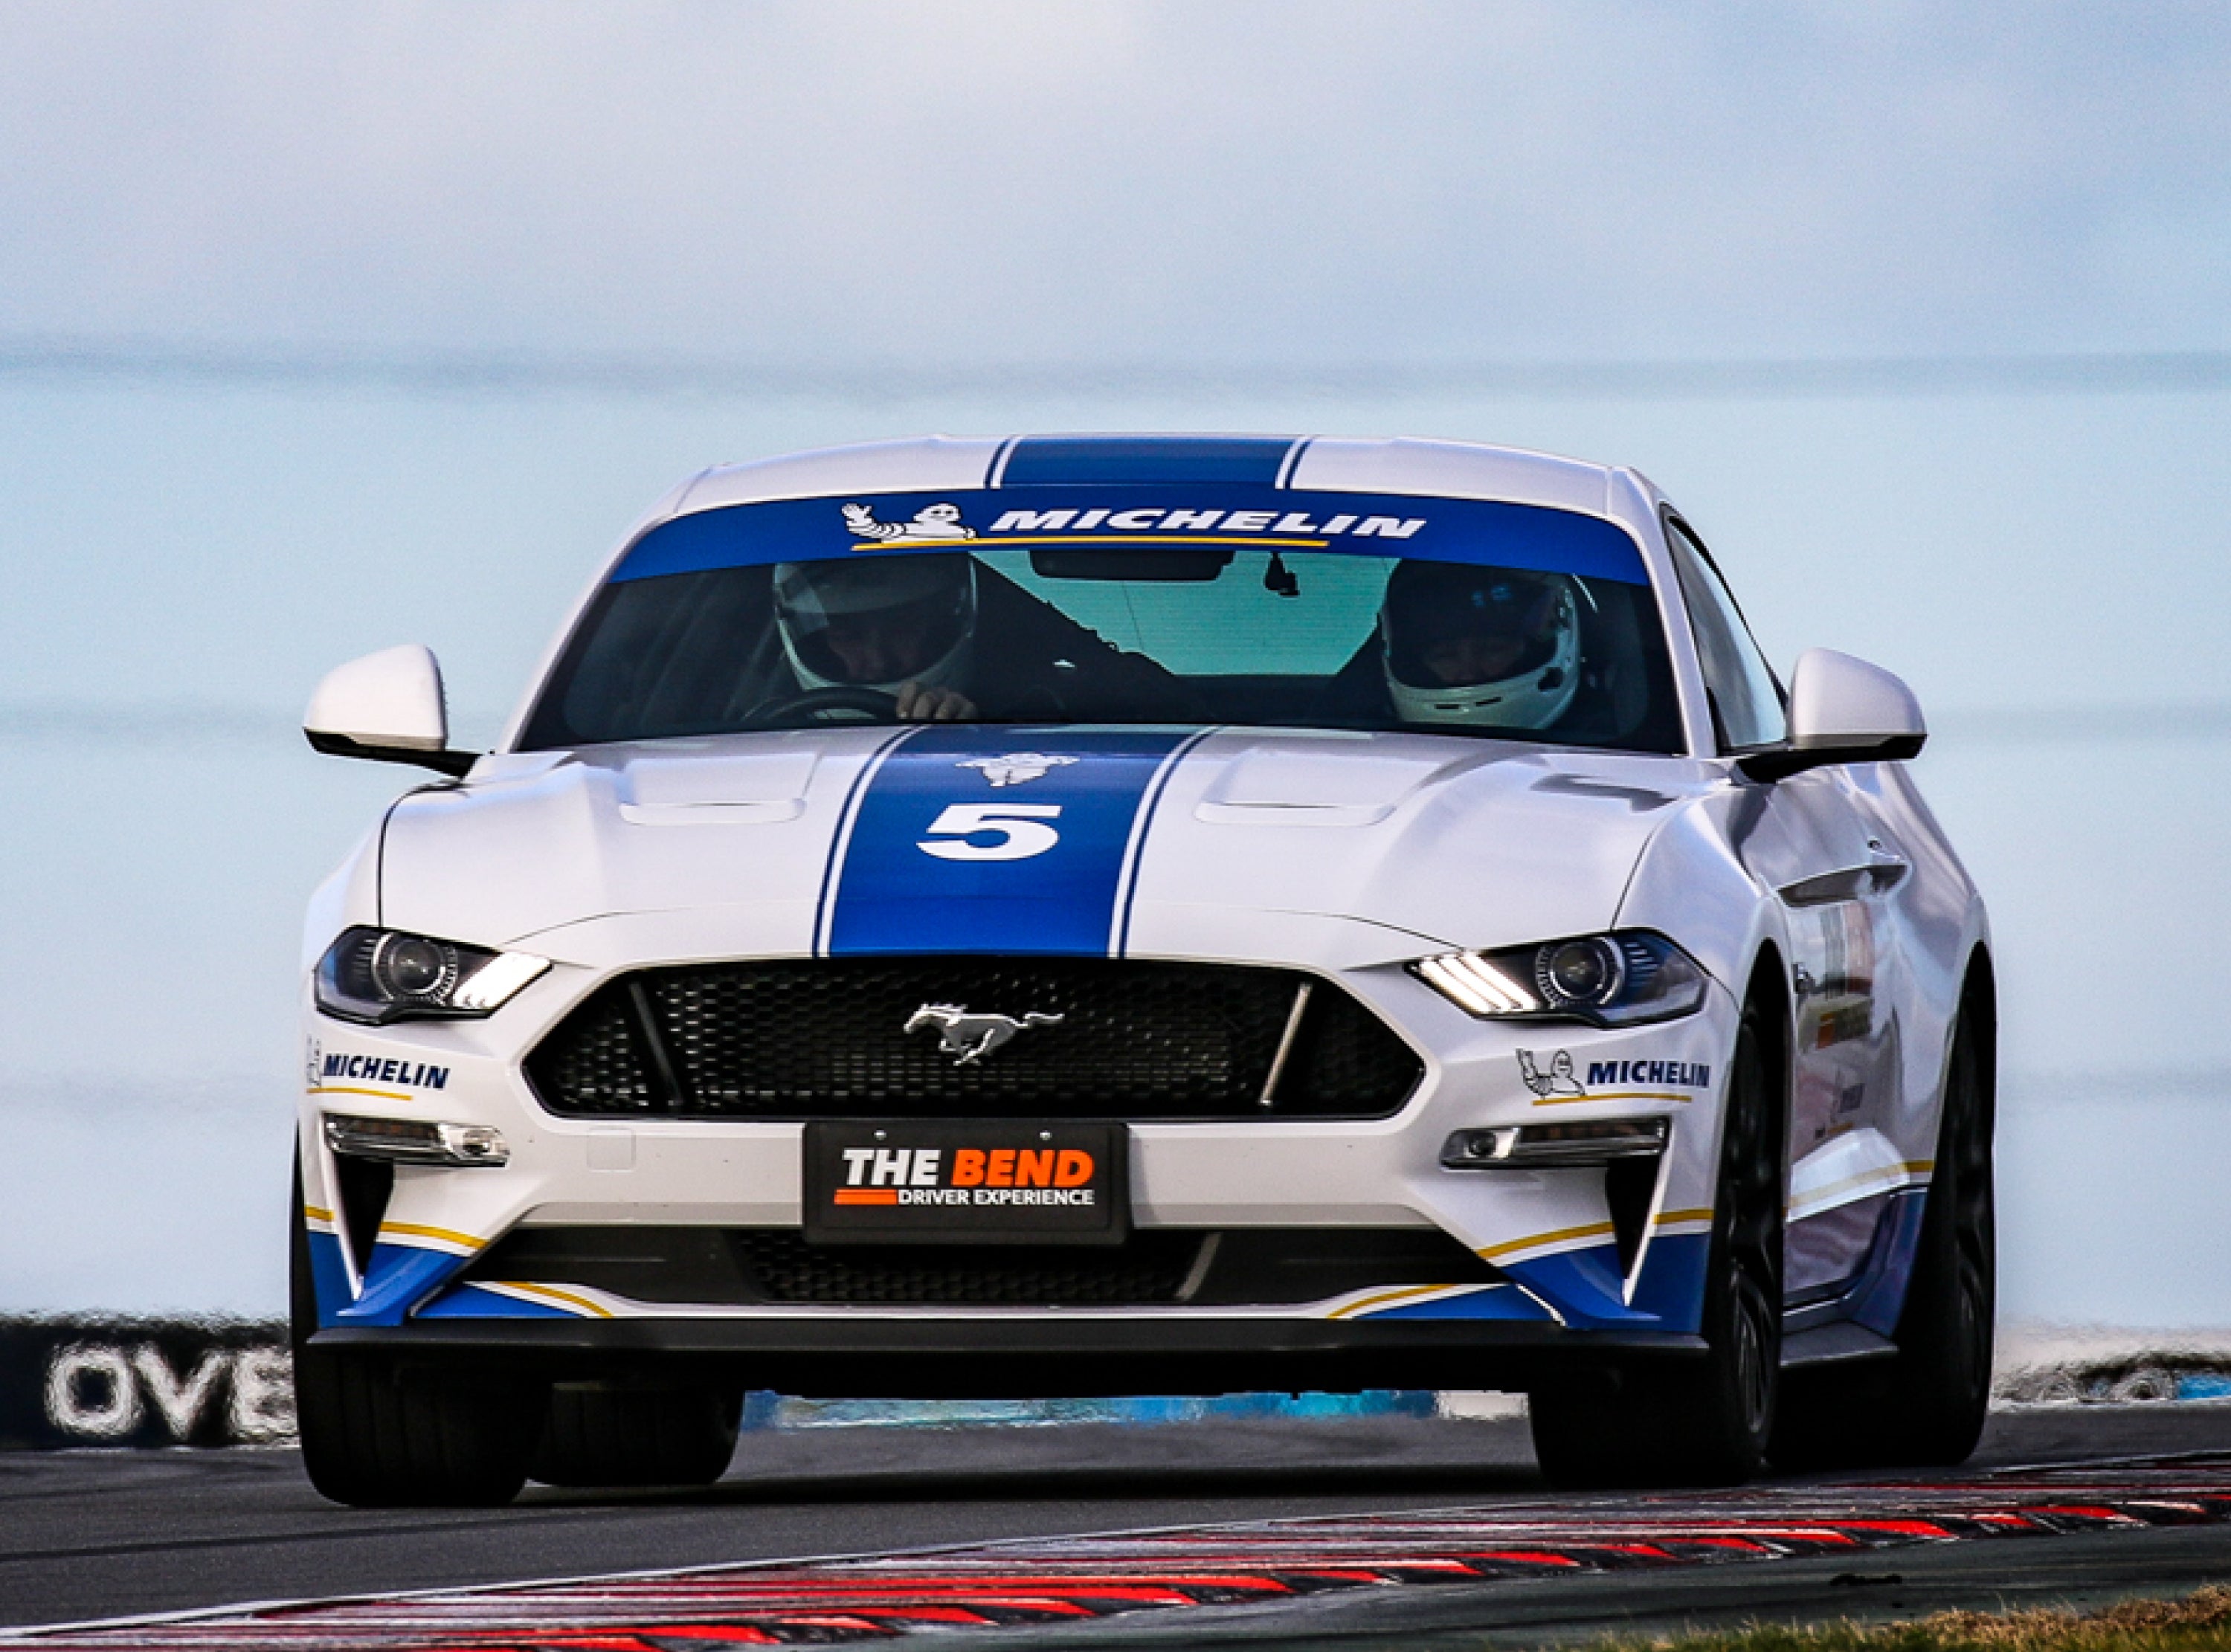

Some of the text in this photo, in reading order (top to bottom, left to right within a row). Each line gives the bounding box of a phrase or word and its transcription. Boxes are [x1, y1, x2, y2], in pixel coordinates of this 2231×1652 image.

[989, 509, 1427, 538] MICHELIN
[915, 803, 1062, 861] 5
[323, 1054, 450, 1089] MICHELIN
[1587, 1059, 1710, 1088] MICHELIN
[842, 1149, 1095, 1187] THE BEND
[898, 1190, 1095, 1205] DRIVER EXPERIENCE
